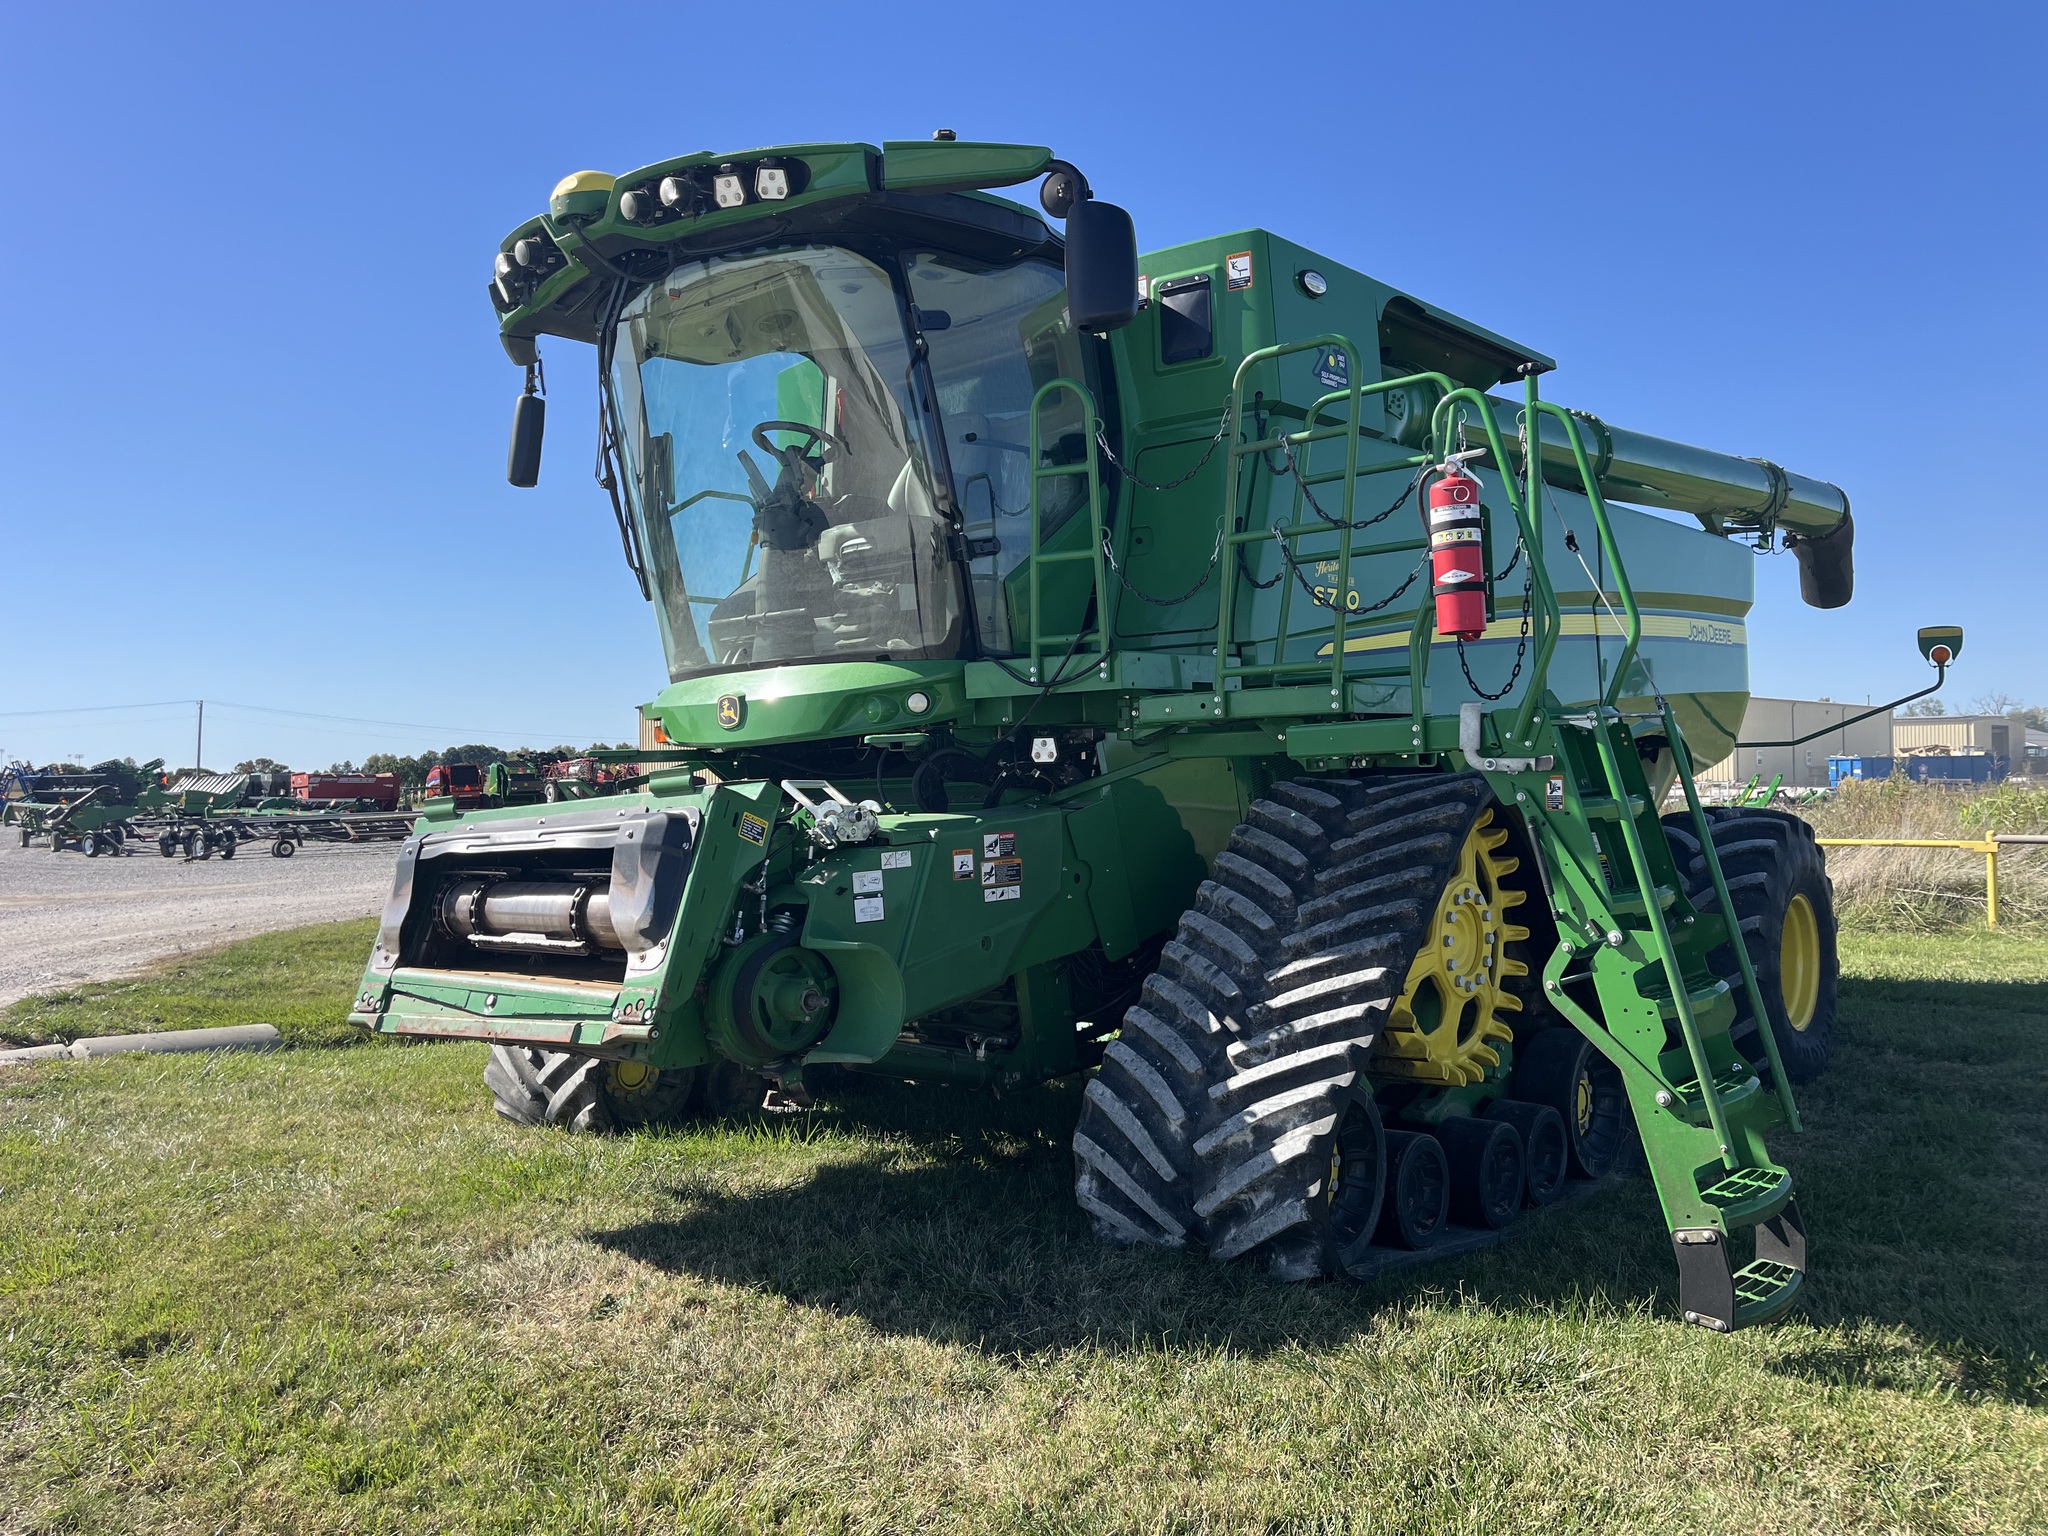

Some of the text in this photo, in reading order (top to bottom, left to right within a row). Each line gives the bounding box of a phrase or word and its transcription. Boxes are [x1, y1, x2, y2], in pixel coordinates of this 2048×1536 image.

[1313, 586, 1360, 610] S70
[1688, 621, 1733, 645] JOHN DEERE
